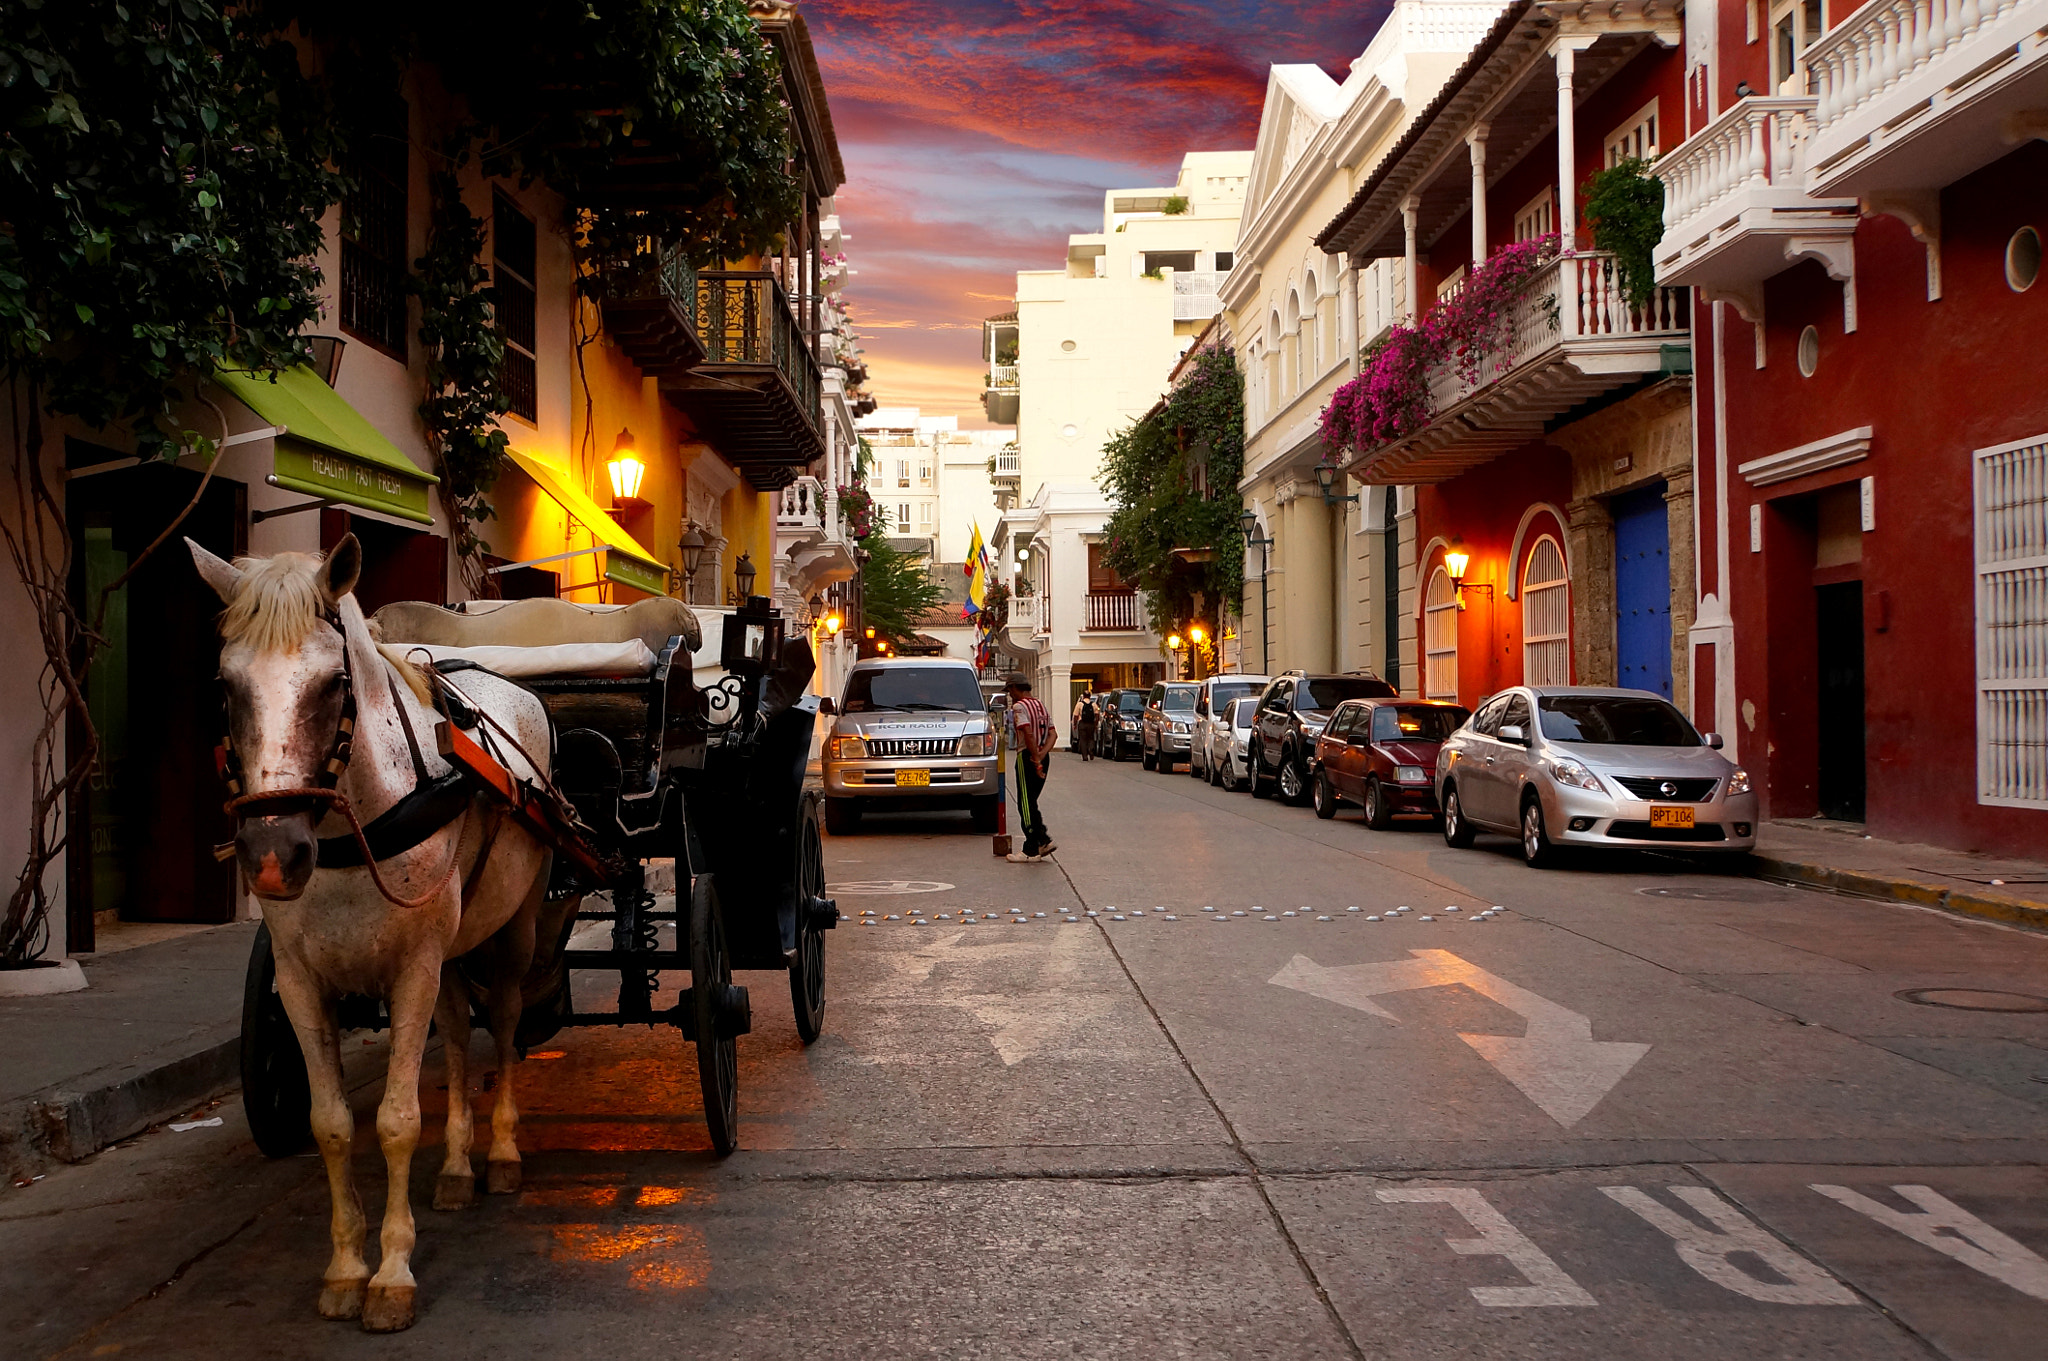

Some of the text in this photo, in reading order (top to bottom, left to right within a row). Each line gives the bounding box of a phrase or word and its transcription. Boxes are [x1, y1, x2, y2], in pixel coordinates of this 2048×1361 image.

[312, 453, 402, 496] HEALTHY FAST FRESH
[908, 722, 947, 730] RADIO
